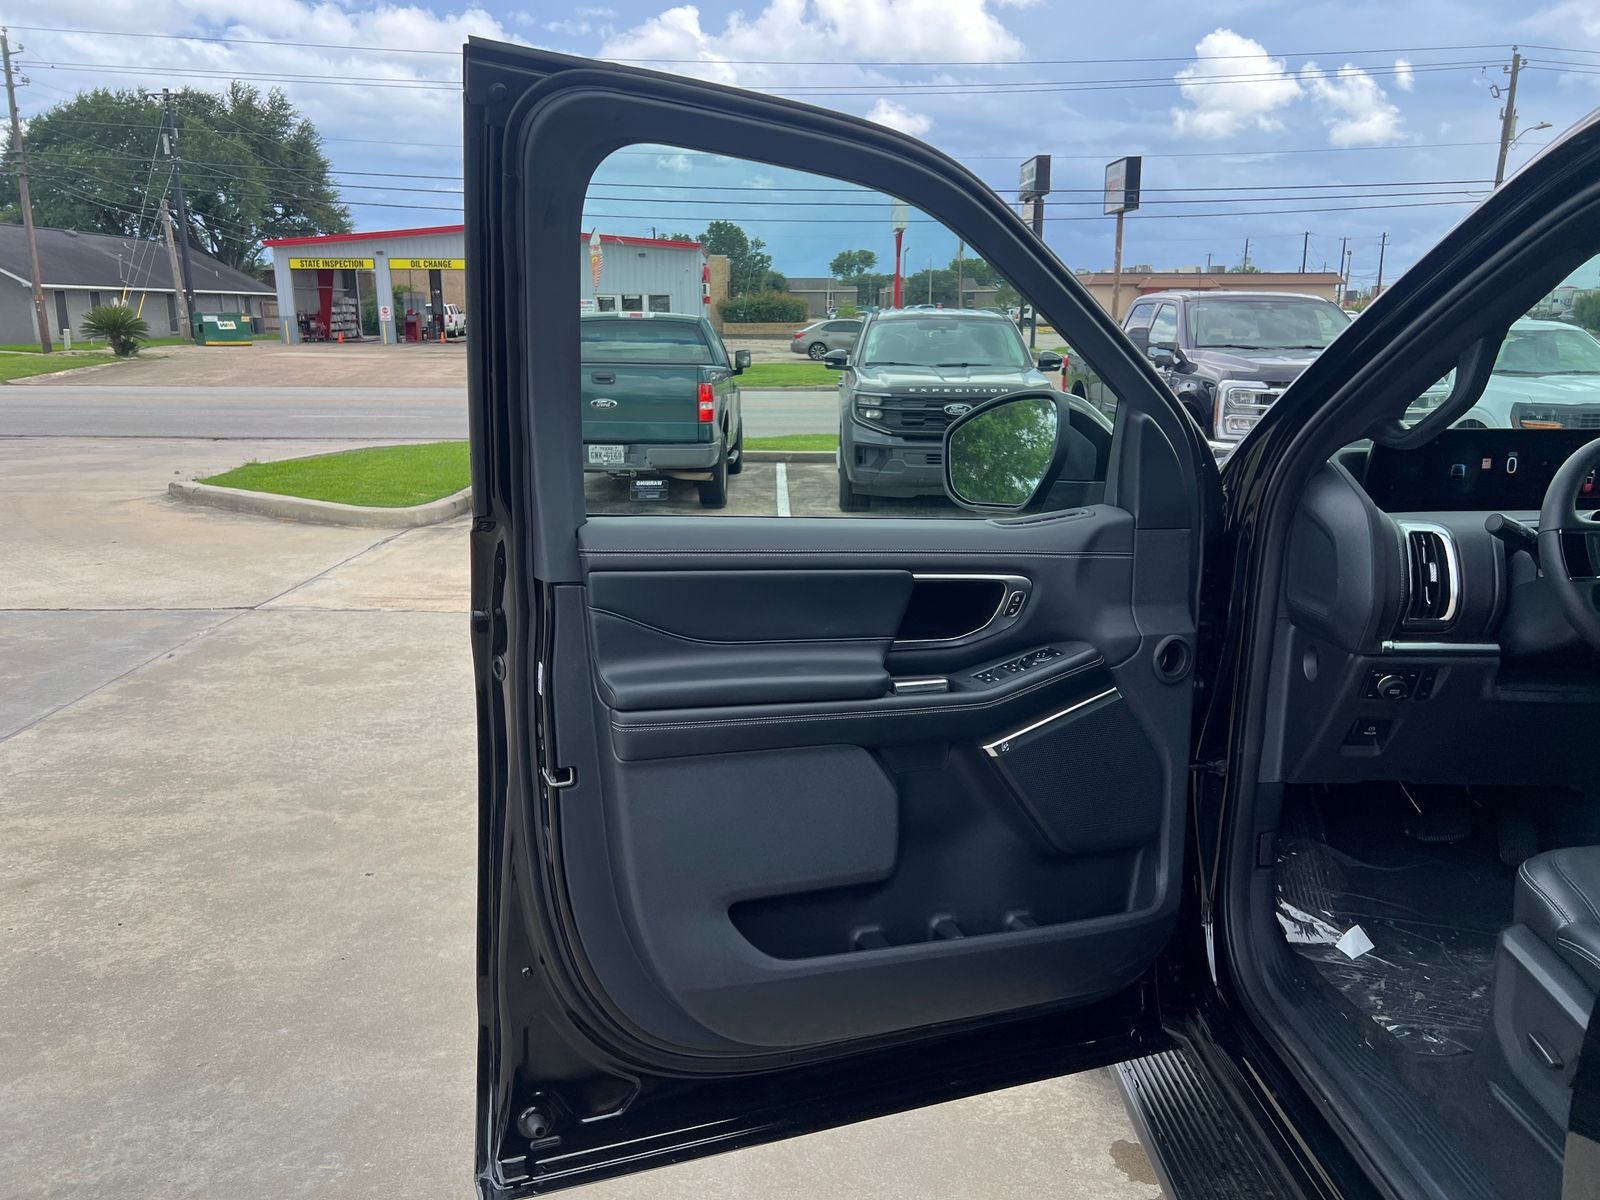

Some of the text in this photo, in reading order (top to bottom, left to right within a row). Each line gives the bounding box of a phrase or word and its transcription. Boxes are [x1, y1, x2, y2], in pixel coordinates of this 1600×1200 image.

[300, 260, 365, 268] STATE INSPECTION
[410, 260, 452, 268] OIL CHANGE
[1506, 456, 1518, 474] 0
